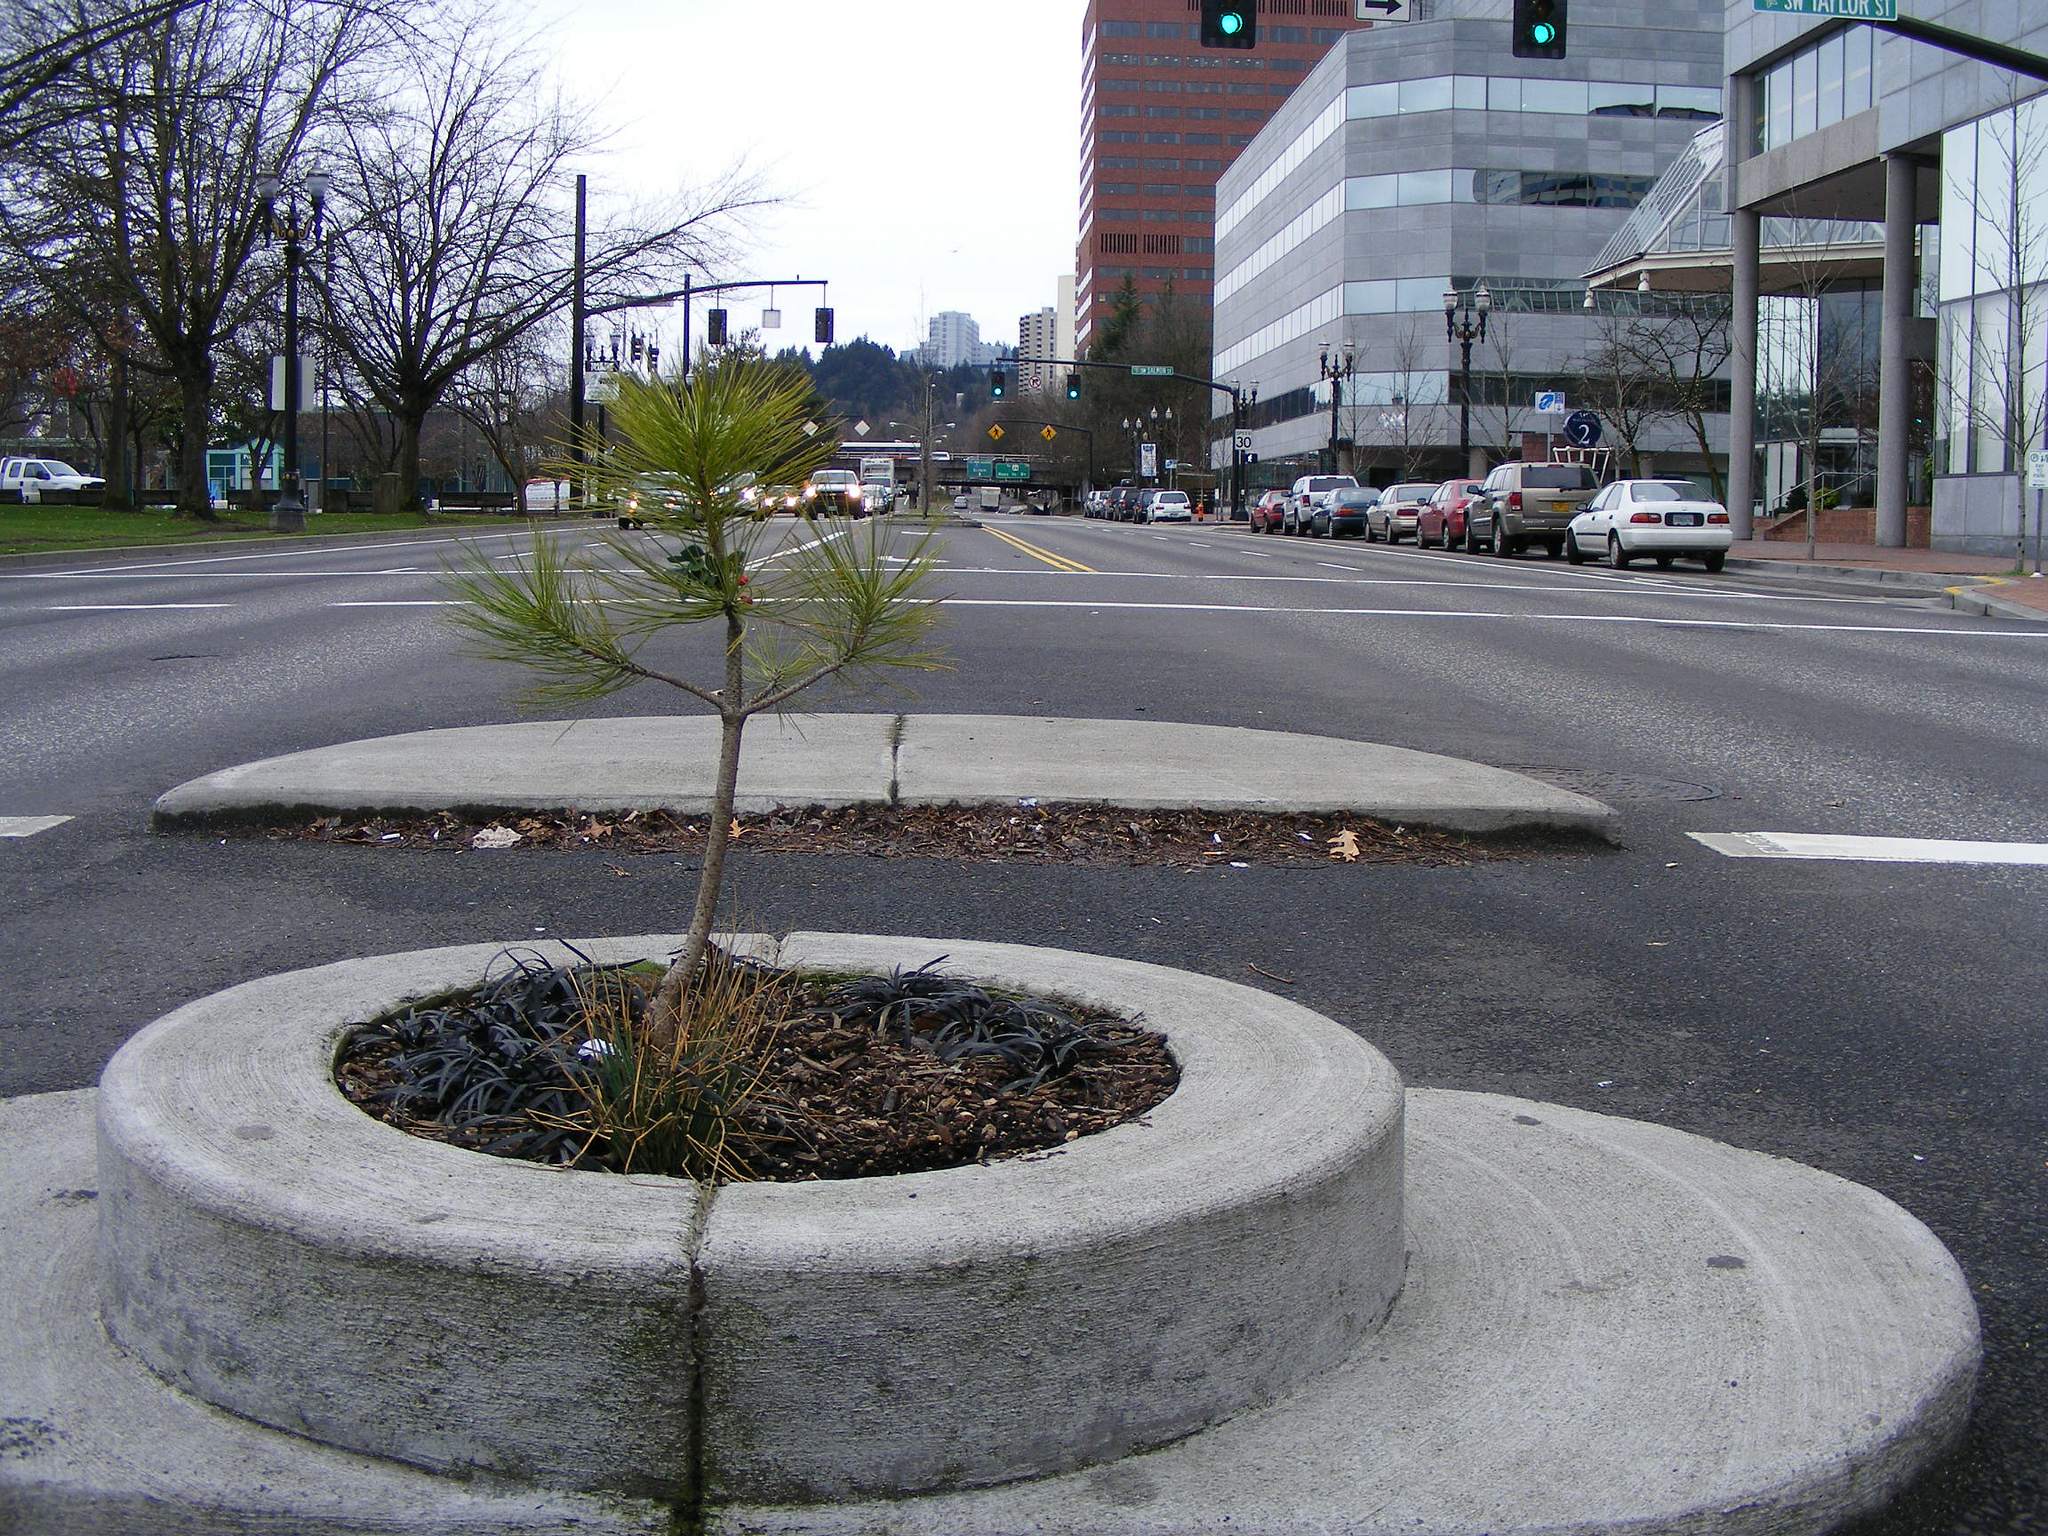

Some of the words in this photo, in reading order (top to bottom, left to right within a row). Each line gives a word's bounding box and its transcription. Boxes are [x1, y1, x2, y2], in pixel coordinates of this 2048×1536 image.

[1812, 0, 1870, 16] TAYLOR
[1875, 0, 1891, 17] ST
[1236, 436, 1252, 448] 30
[1578, 424, 1590, 444] 2
